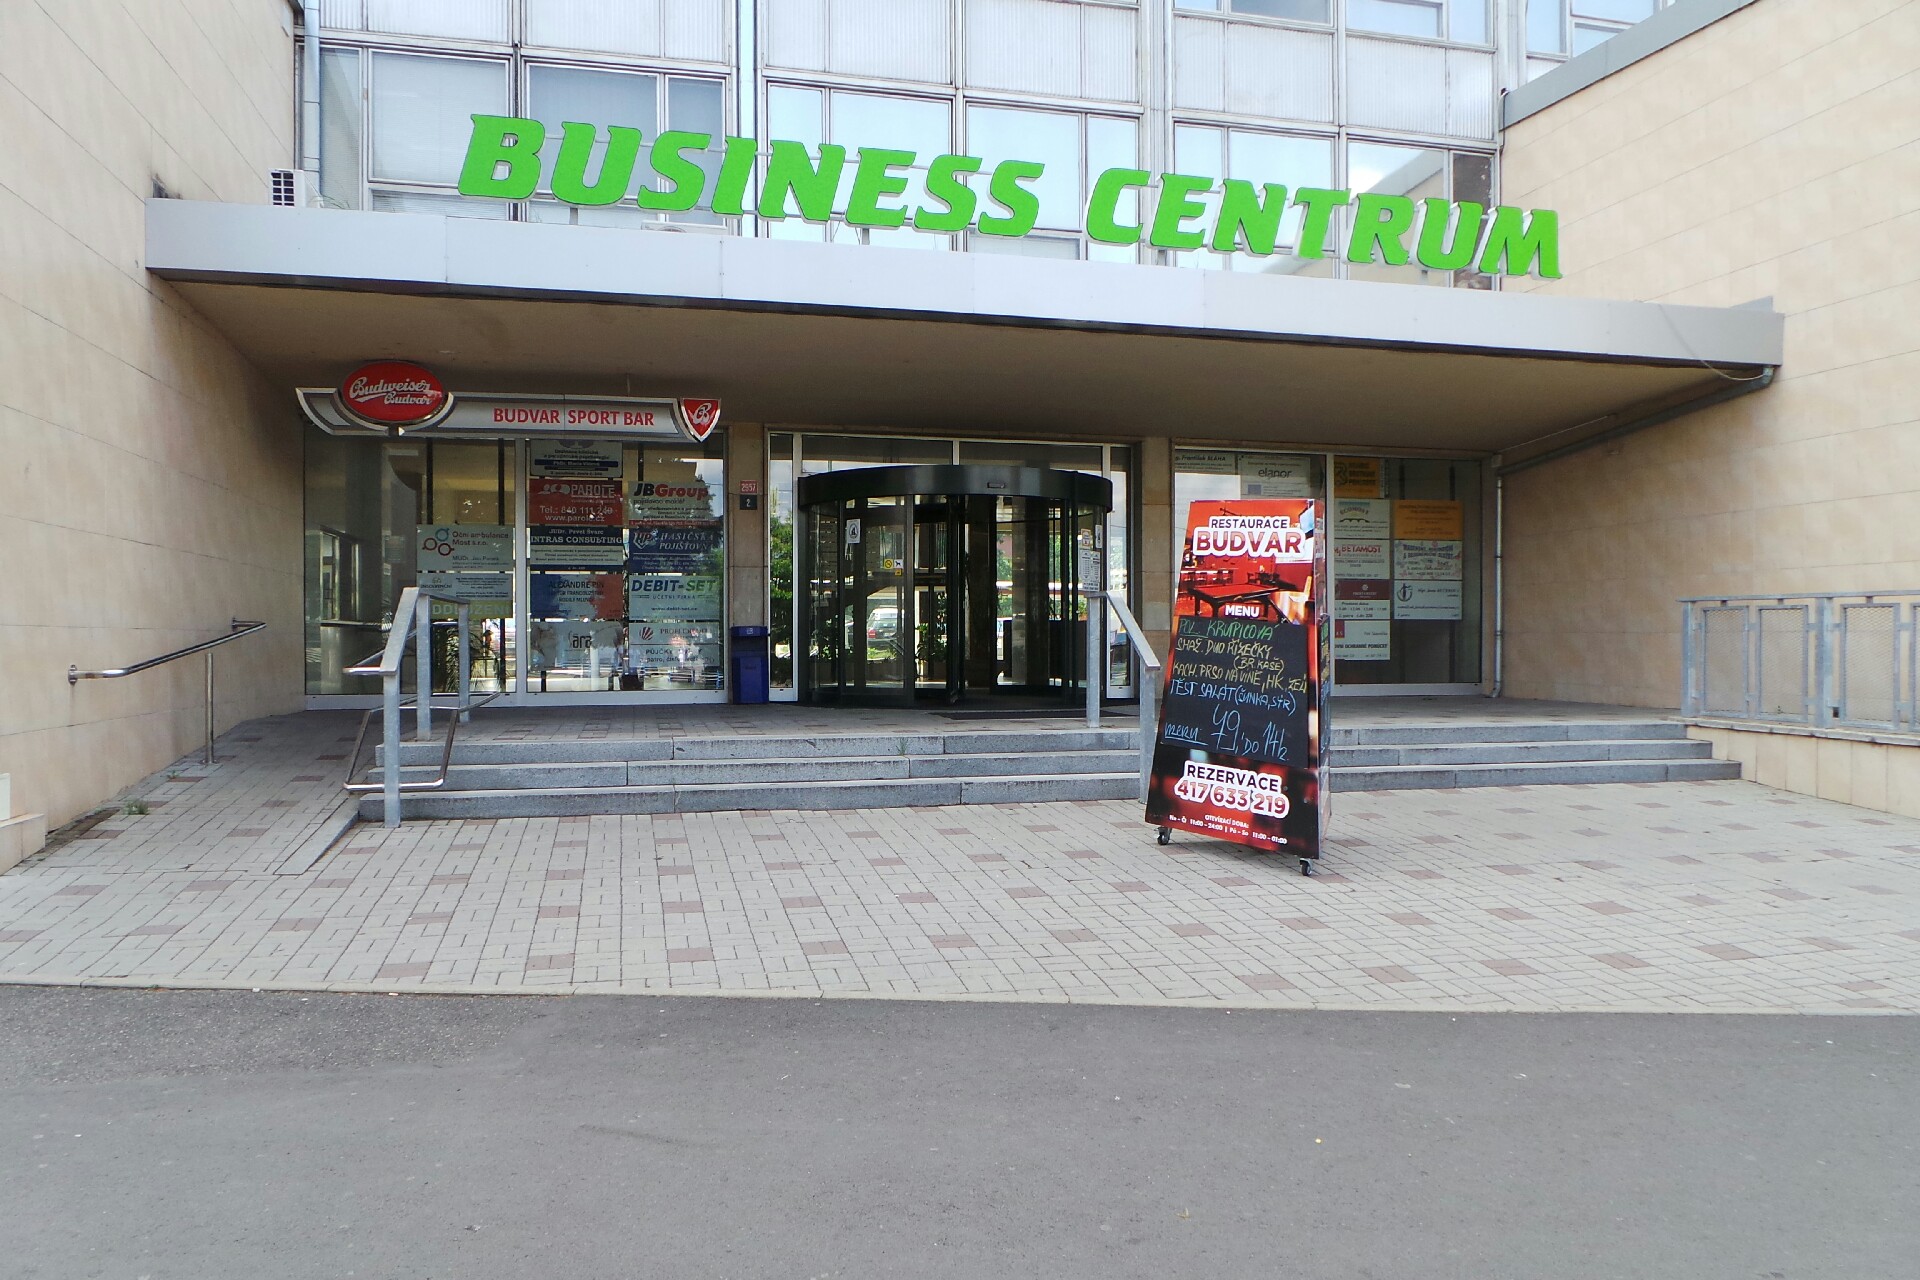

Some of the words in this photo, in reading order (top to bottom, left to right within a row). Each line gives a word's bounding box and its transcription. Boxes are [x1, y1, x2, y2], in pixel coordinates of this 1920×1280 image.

[458, 113, 1045, 238] BUSINESS
[1086, 167, 1562, 279] CENTRUM
[350, 376, 431, 399] Budweiser
[384, 391, 432, 405] Budvar
[493, 408, 560, 424] BUDVAR
[567, 409, 620, 426] SPORT
[623, 411, 655, 427] BAR
[571, 484, 615, 498] PAROLE
[633, 483, 709, 501] JBGroup
[540, 505, 559, 514] Tel.:
[560, 506, 577, 514] 840
[579, 506, 594, 514] 111
[745, 498, 751, 508] 2
[544, 514, 605, 522] www.parole.cz
[1211, 518, 1289, 529] RESTAURACE
[470, 531, 509, 539] ambulance
[530, 535, 564, 543] INTRAS
[565, 536, 623, 544] CONSULTING
[1196, 530, 1302, 554] BUDVAR
[631, 579, 717, 592] DEBIT-SET
[1224, 604, 1260, 618] MENU
[1187, 764, 1279, 792] REZERVACE
[1177, 779, 1208, 799] 417
[1213, 785, 1248, 808] 633
[1253, 793, 1287, 815] 219
[1204, 813, 1231, 826] OTEVÍRACÍ
[1207, 822, 1223, 832] 24:00
[1252, 831, 1267, 840] 11:00
